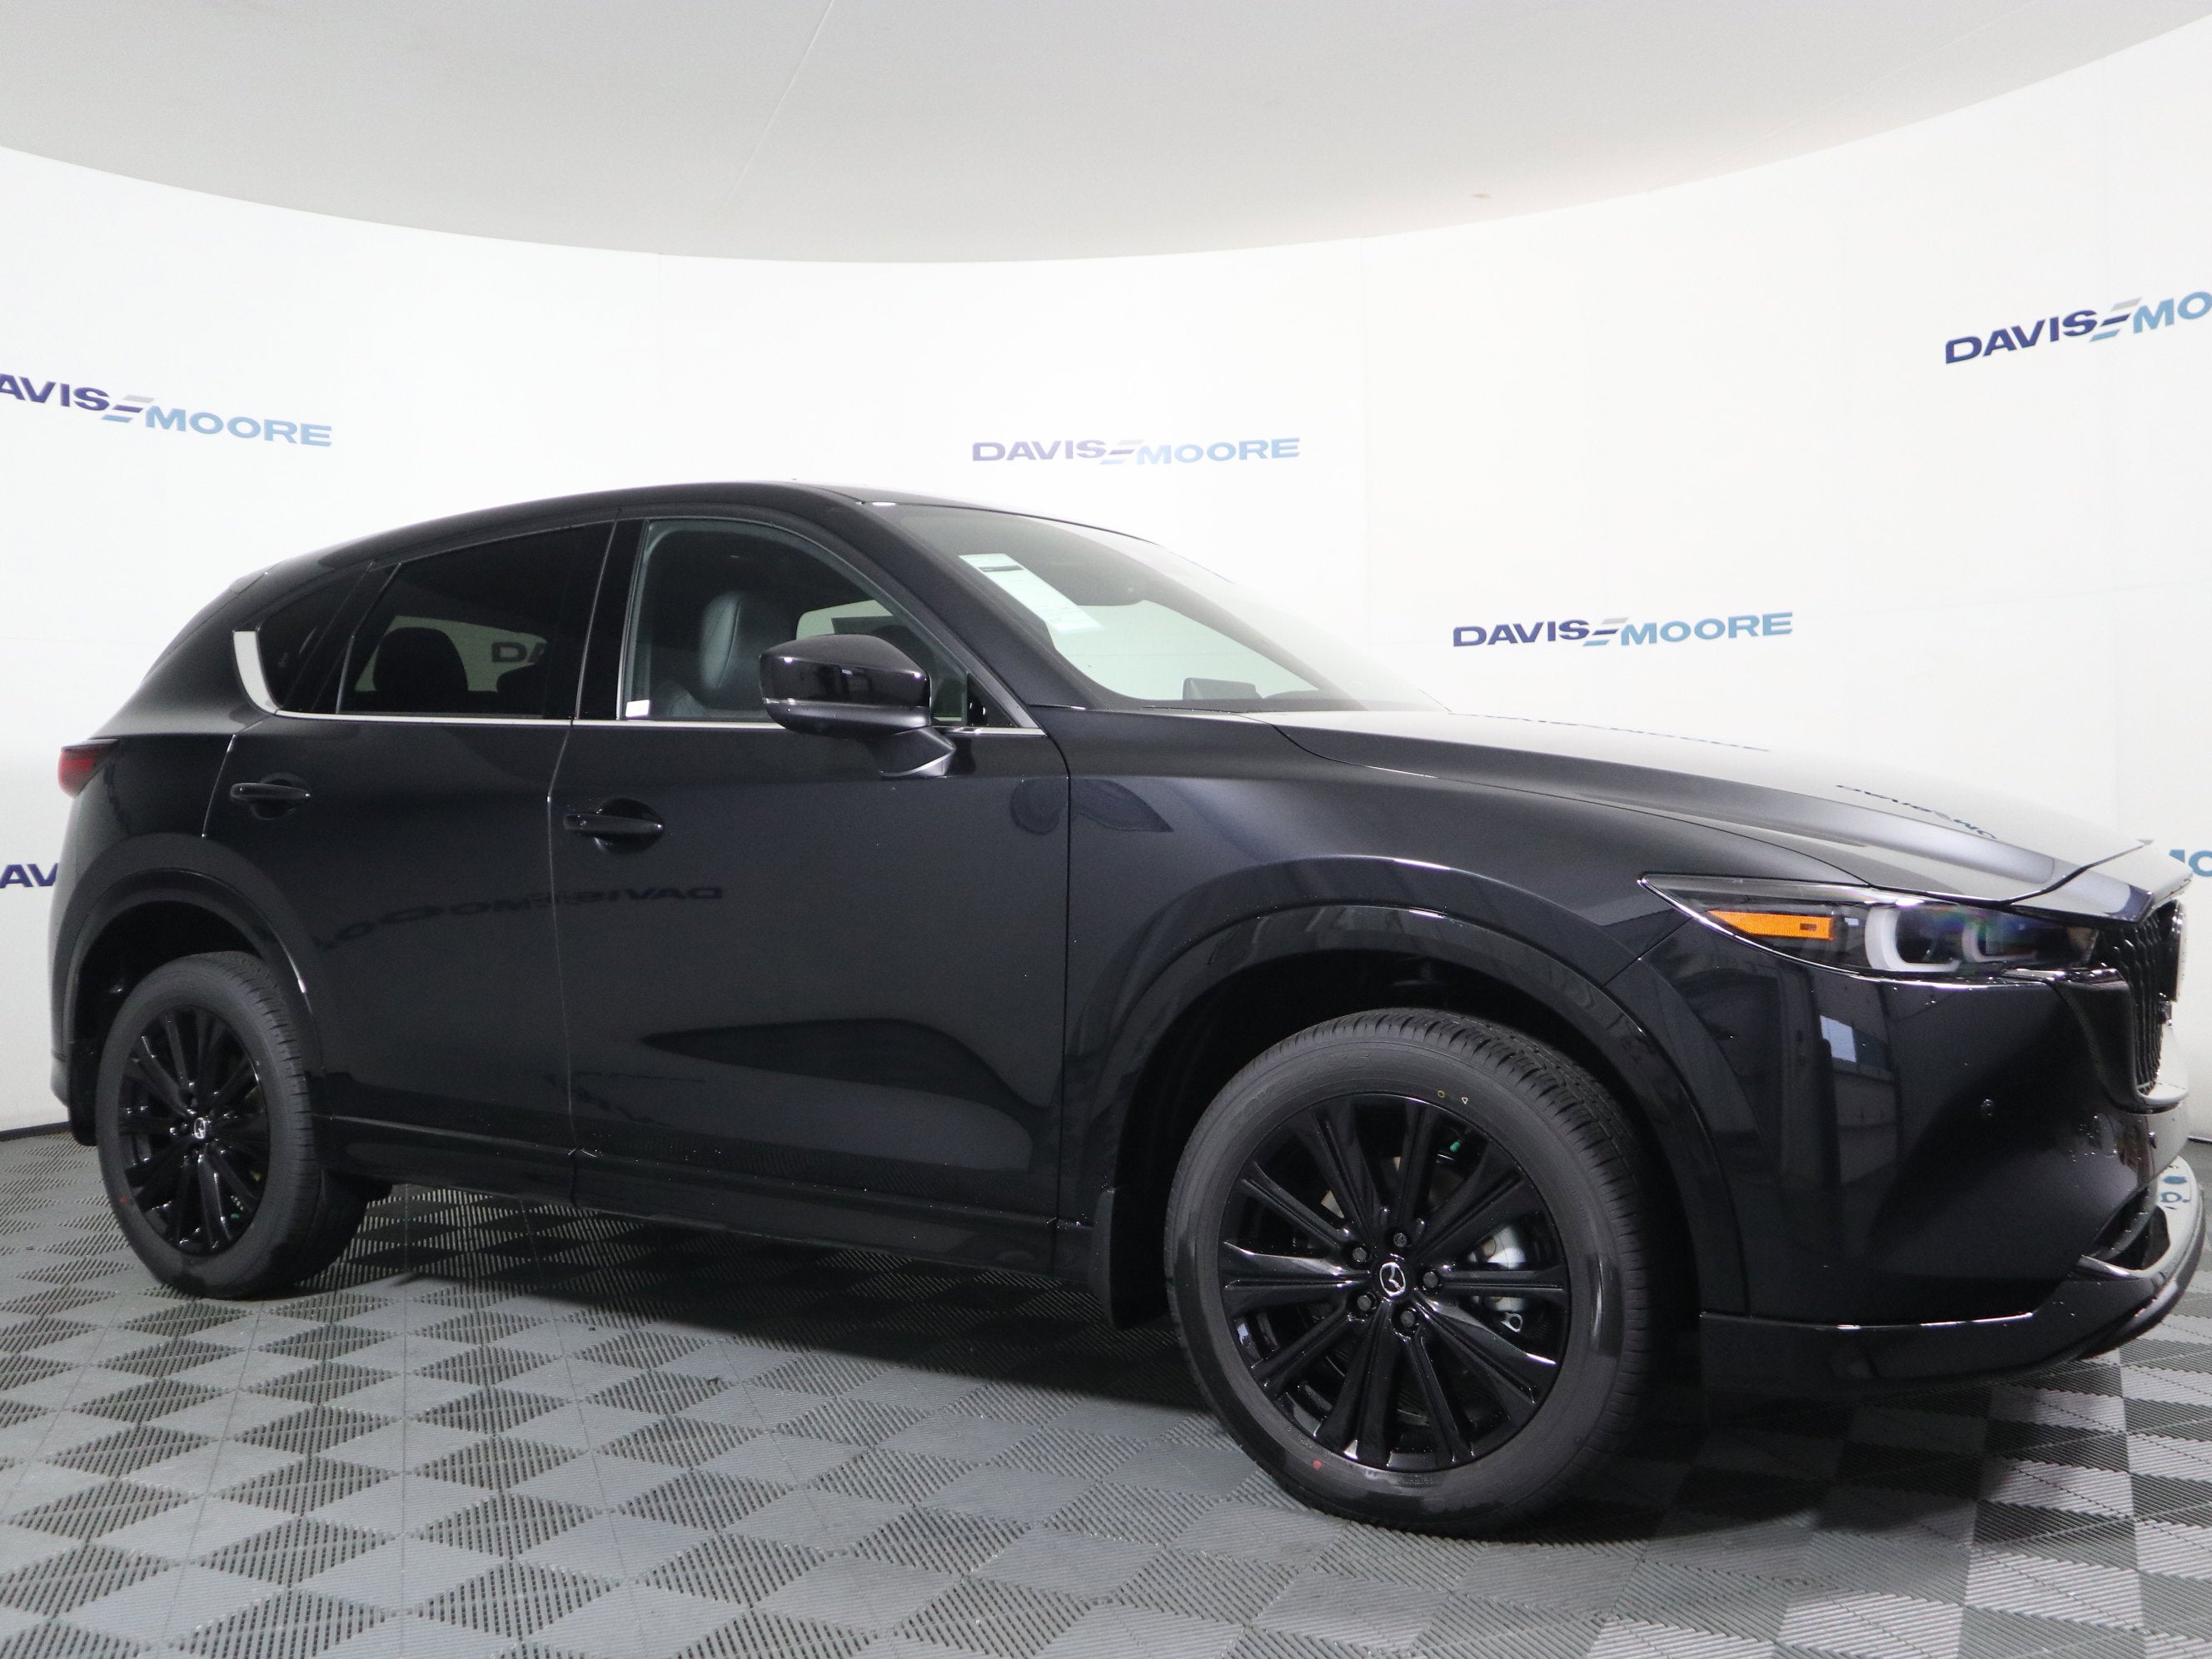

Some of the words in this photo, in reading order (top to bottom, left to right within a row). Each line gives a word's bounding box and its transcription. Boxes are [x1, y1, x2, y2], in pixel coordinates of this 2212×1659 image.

[1945, 310, 2098, 364] DAVIS
[145, 406, 332, 447] MOORE
[972, 439, 1107, 461] DAVIS
[1137, 437, 1300, 465] MOORE
[1452, 619, 1590, 646] DAVIS
[1621, 611, 1793, 646] MOORE
